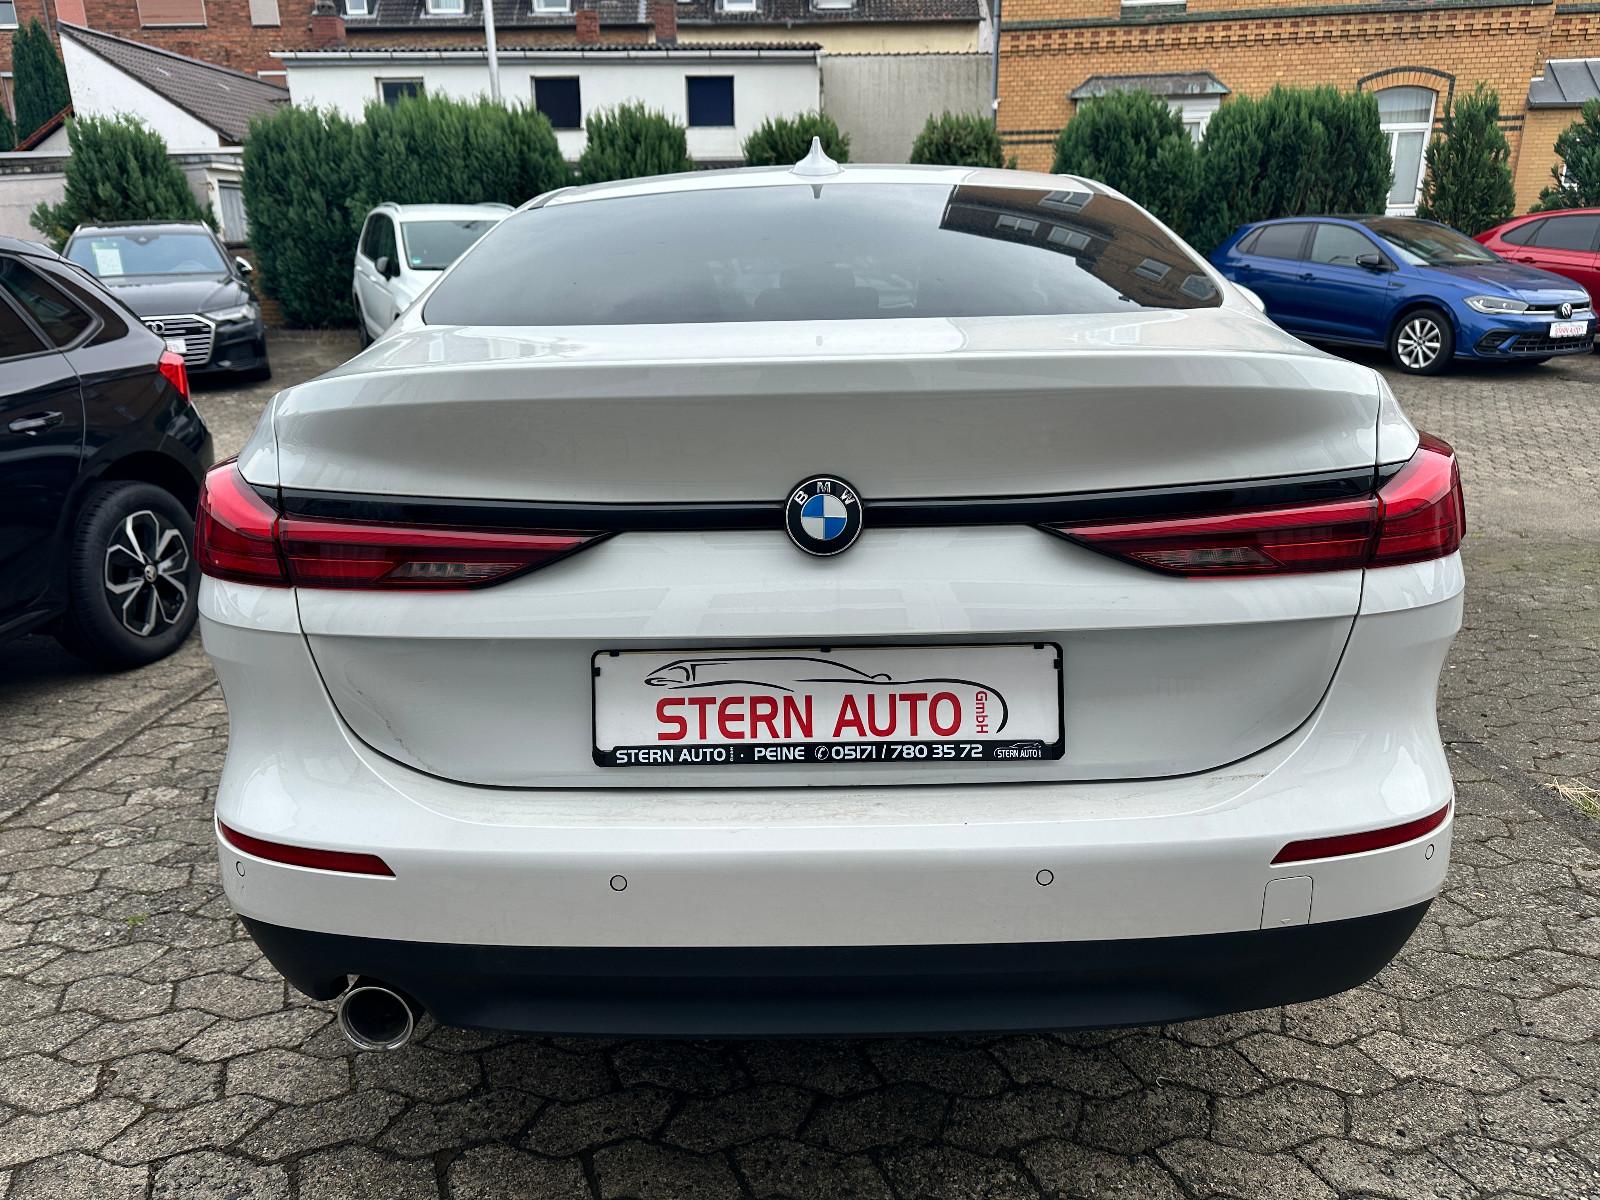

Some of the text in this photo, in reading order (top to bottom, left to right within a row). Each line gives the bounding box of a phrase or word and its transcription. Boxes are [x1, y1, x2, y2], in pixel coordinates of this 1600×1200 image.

[794, 482, 855, 506] BMW
[656, 691, 962, 740] STERN AUTO
[975, 690, 988, 734] GmbH
[615, 749, 674, 764] STERN
[679, 747, 726, 763] AUTO
[754, 747, 805, 761] PEINE
[831, 745, 876, 760] 05171
[891, 745, 928, 759] 780
[932, 744, 955, 758] 35
[960, 744, 983, 757] 72
[997, 749, 1019, 758] STERN
[1020, 749, 1038, 758] AUTO
